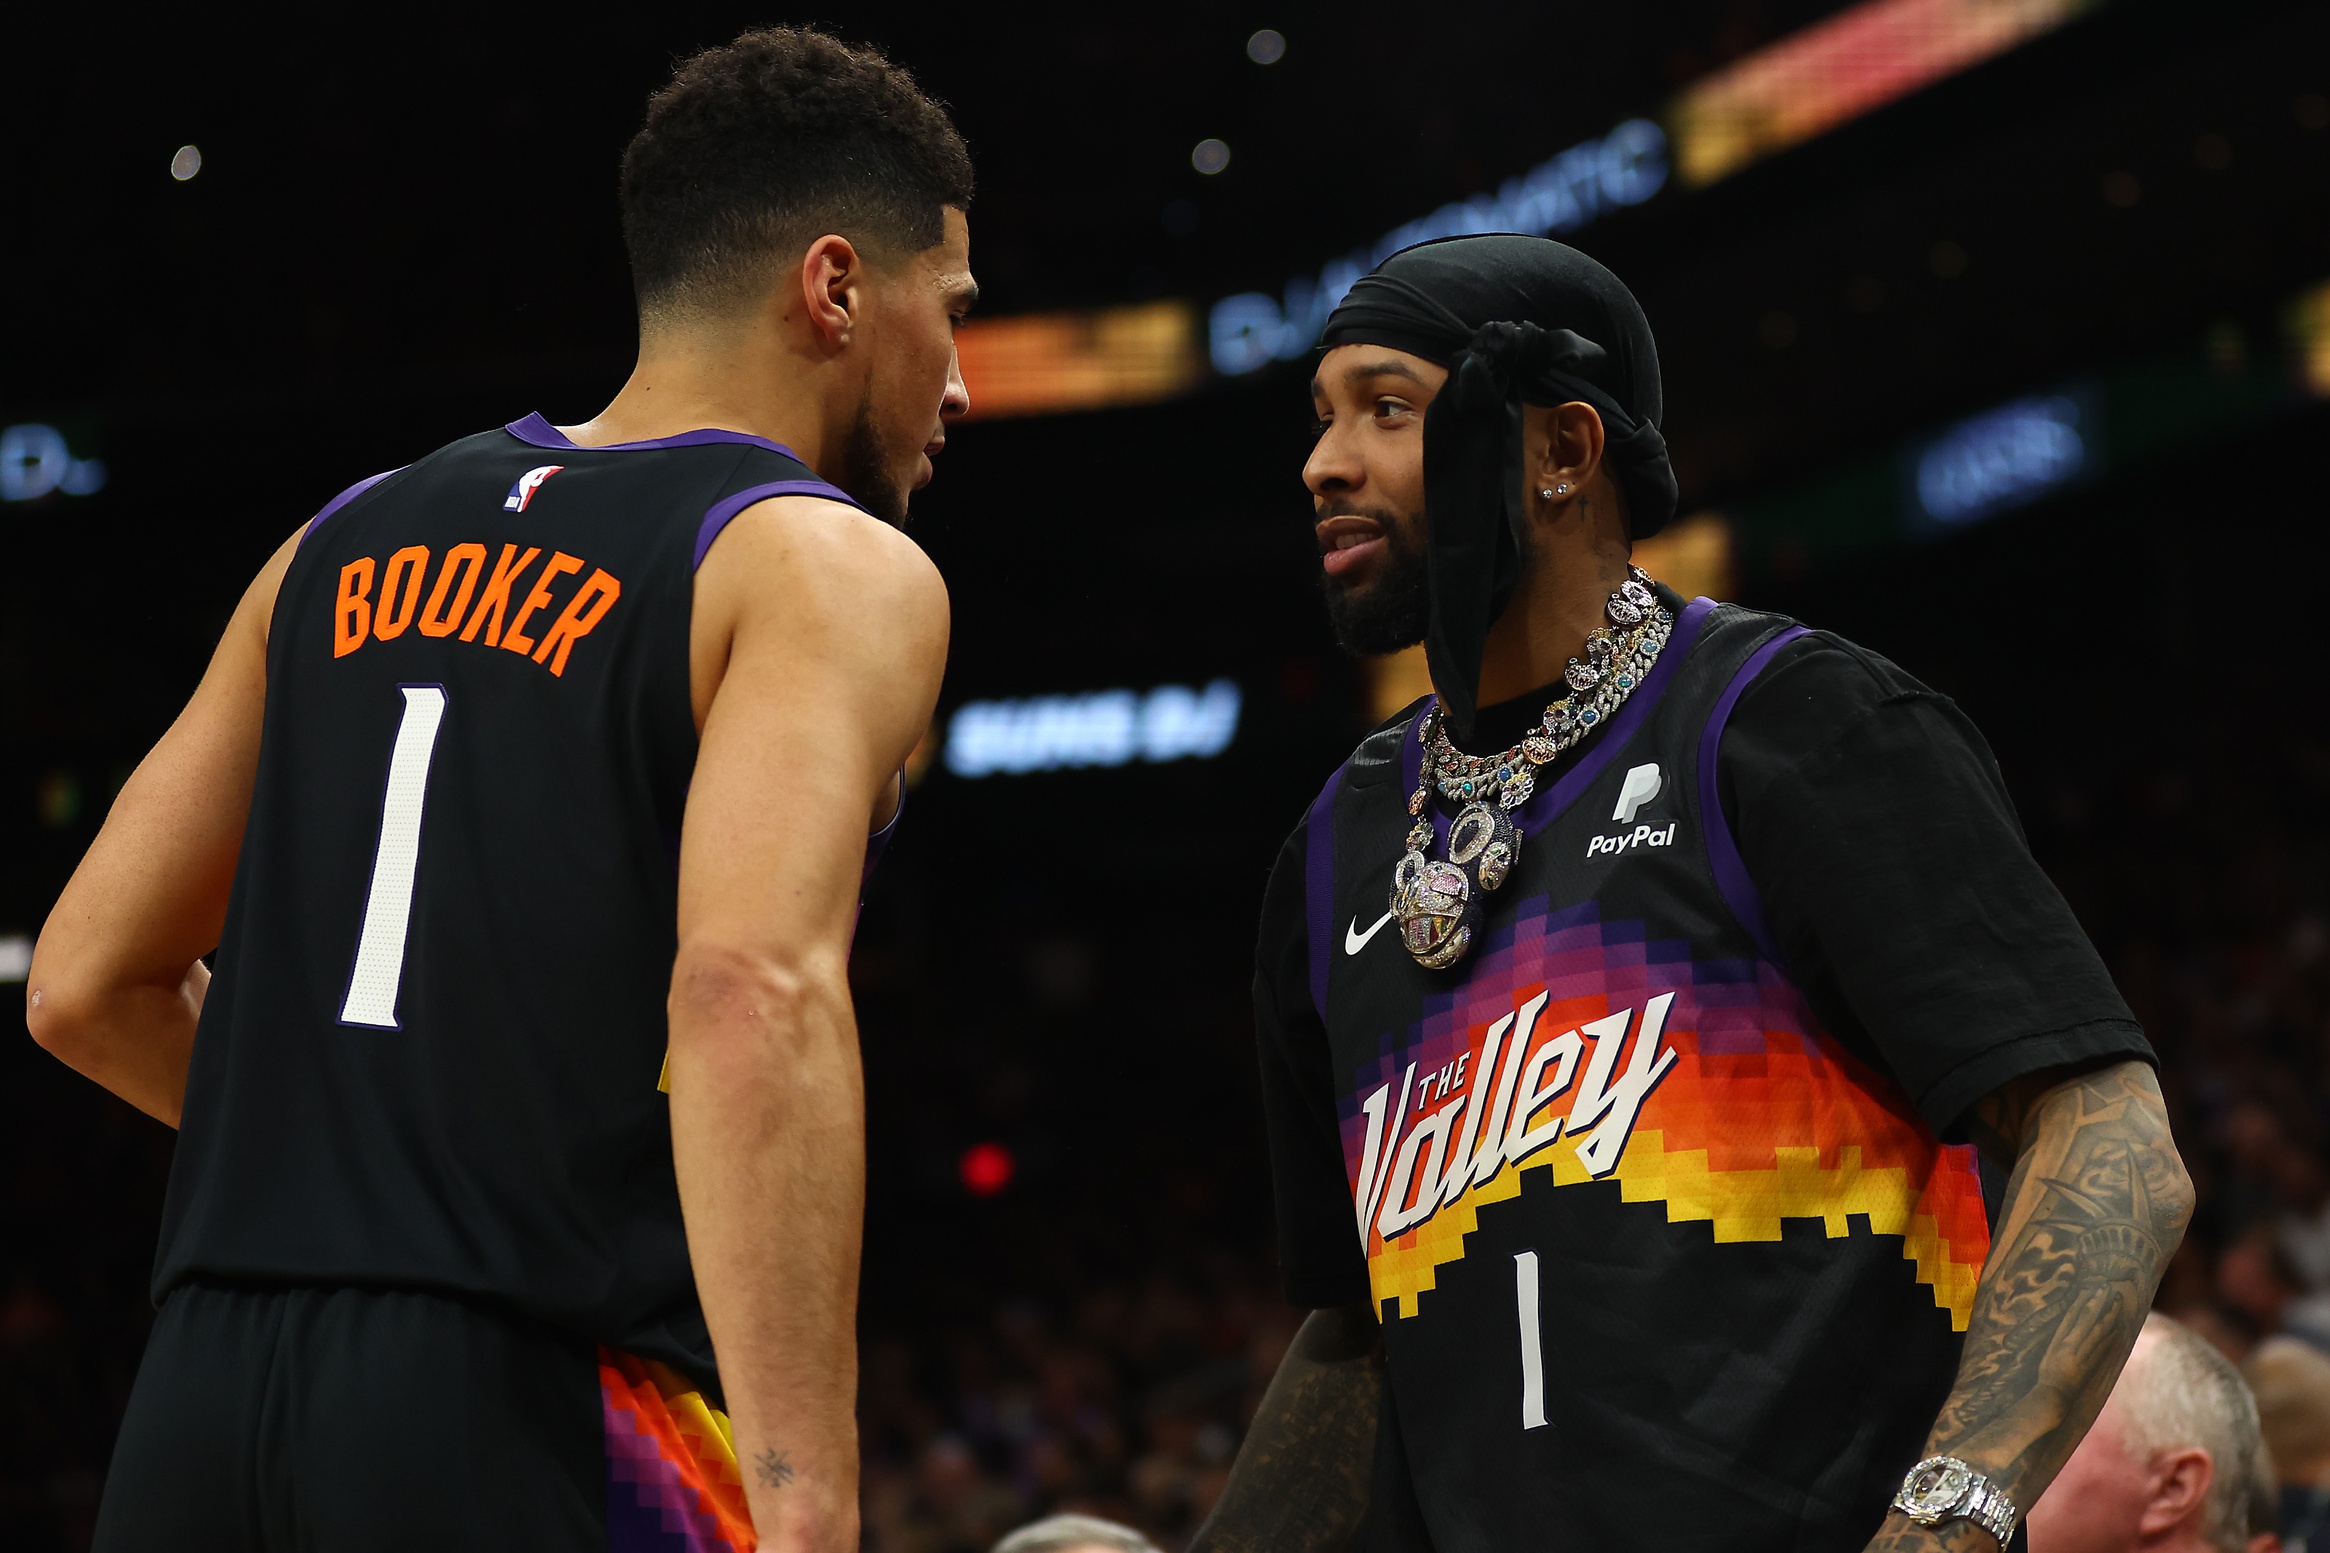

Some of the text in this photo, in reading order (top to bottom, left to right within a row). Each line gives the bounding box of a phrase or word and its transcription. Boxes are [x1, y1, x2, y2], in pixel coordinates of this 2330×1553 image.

[333, 542, 621, 678] BOOKER
[338, 684, 448, 1030] 1
[1586, 822, 1676, 858] PayPal
[1354, 990, 1680, 1261] Valley
[1417, 1051, 1471, 1110] THE
[1512, 1250, 1549, 1431] 1
